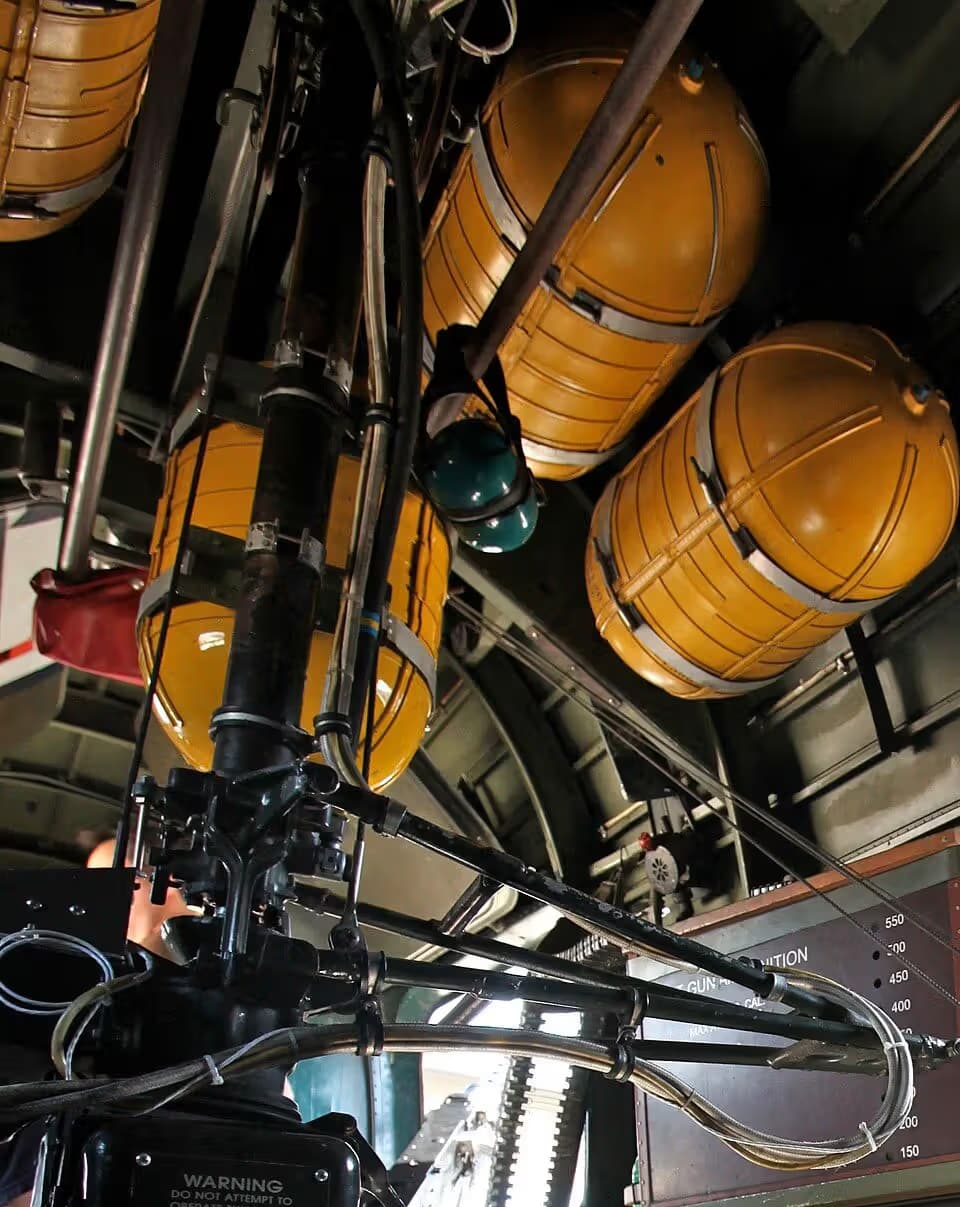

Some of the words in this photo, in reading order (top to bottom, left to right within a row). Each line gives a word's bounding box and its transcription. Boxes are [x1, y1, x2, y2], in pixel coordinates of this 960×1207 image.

[885, 913, 904, 928] 550
[889, 969, 909, 984] 450
[687, 976, 716, 994] GUN
[891, 998, 911, 1013] 400
[901, 1144, 919, 1158] 150
[184, 1173, 284, 1193] WARNING
[171, 1189, 191, 1199] DO
[195, 1191, 221, 1200] NOT
[225, 1193, 274, 1204] ATTEMPT
[278, 1196, 293, 1206] TO
